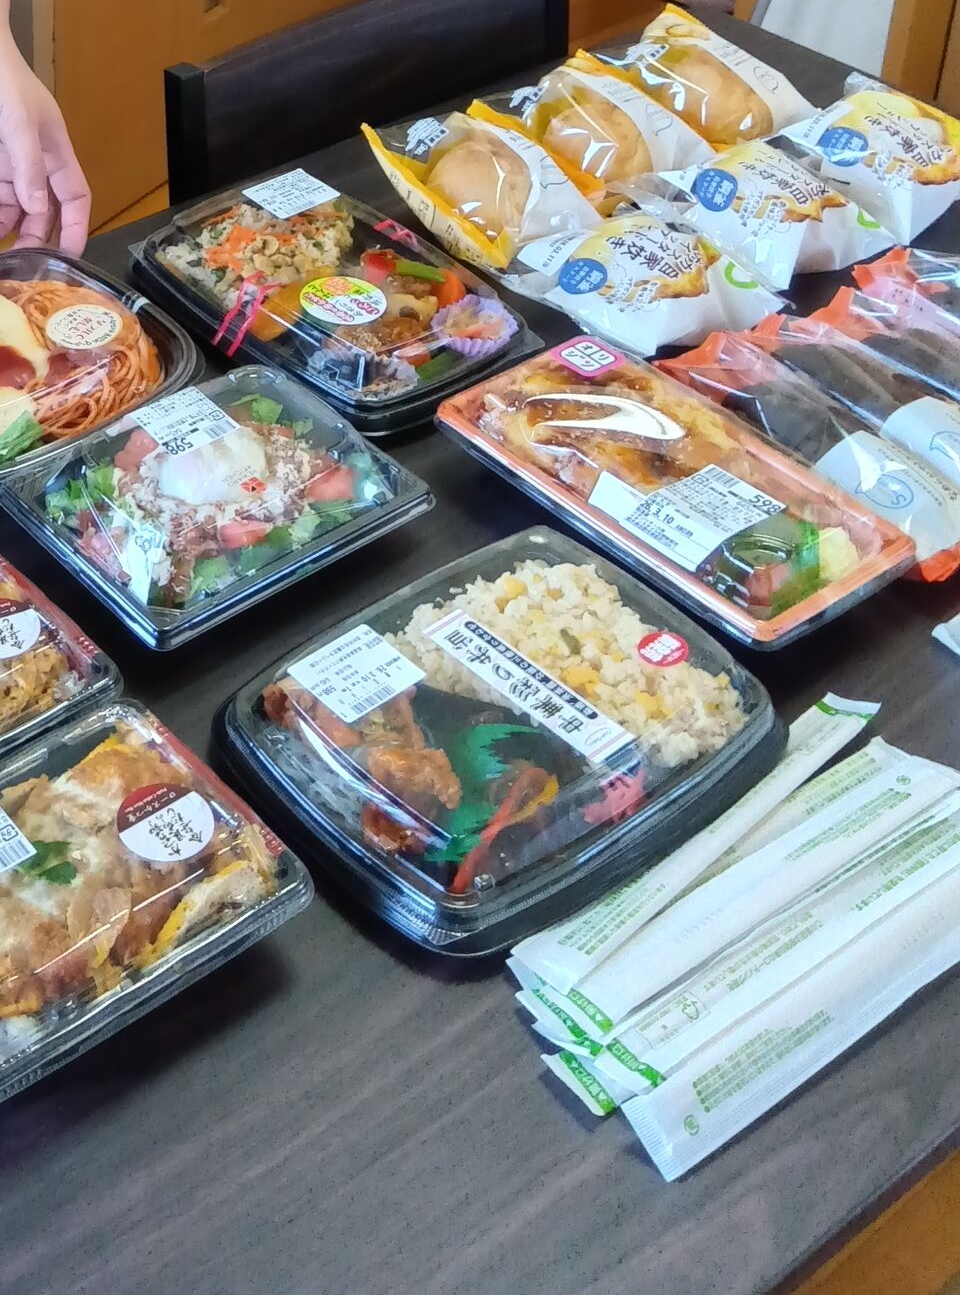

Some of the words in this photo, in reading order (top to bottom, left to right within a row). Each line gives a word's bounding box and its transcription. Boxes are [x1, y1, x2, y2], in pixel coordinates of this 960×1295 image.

[738, 162, 811, 206] 自家炊き
[604, 237, 681, 281] 自家炊き
[575, 268, 604, 294] 銅釜
[164, 437, 193, 456] 598
[639, 500, 653, 512] 26.
[662, 513, 675, 524] 10
[748, 493, 781, 513] 598
[443, 626, 584, 738] 中華彩り弁当
[126, 791, 176, 823] ロースかつ重
[574, 1068, 601, 1095] 開け口
